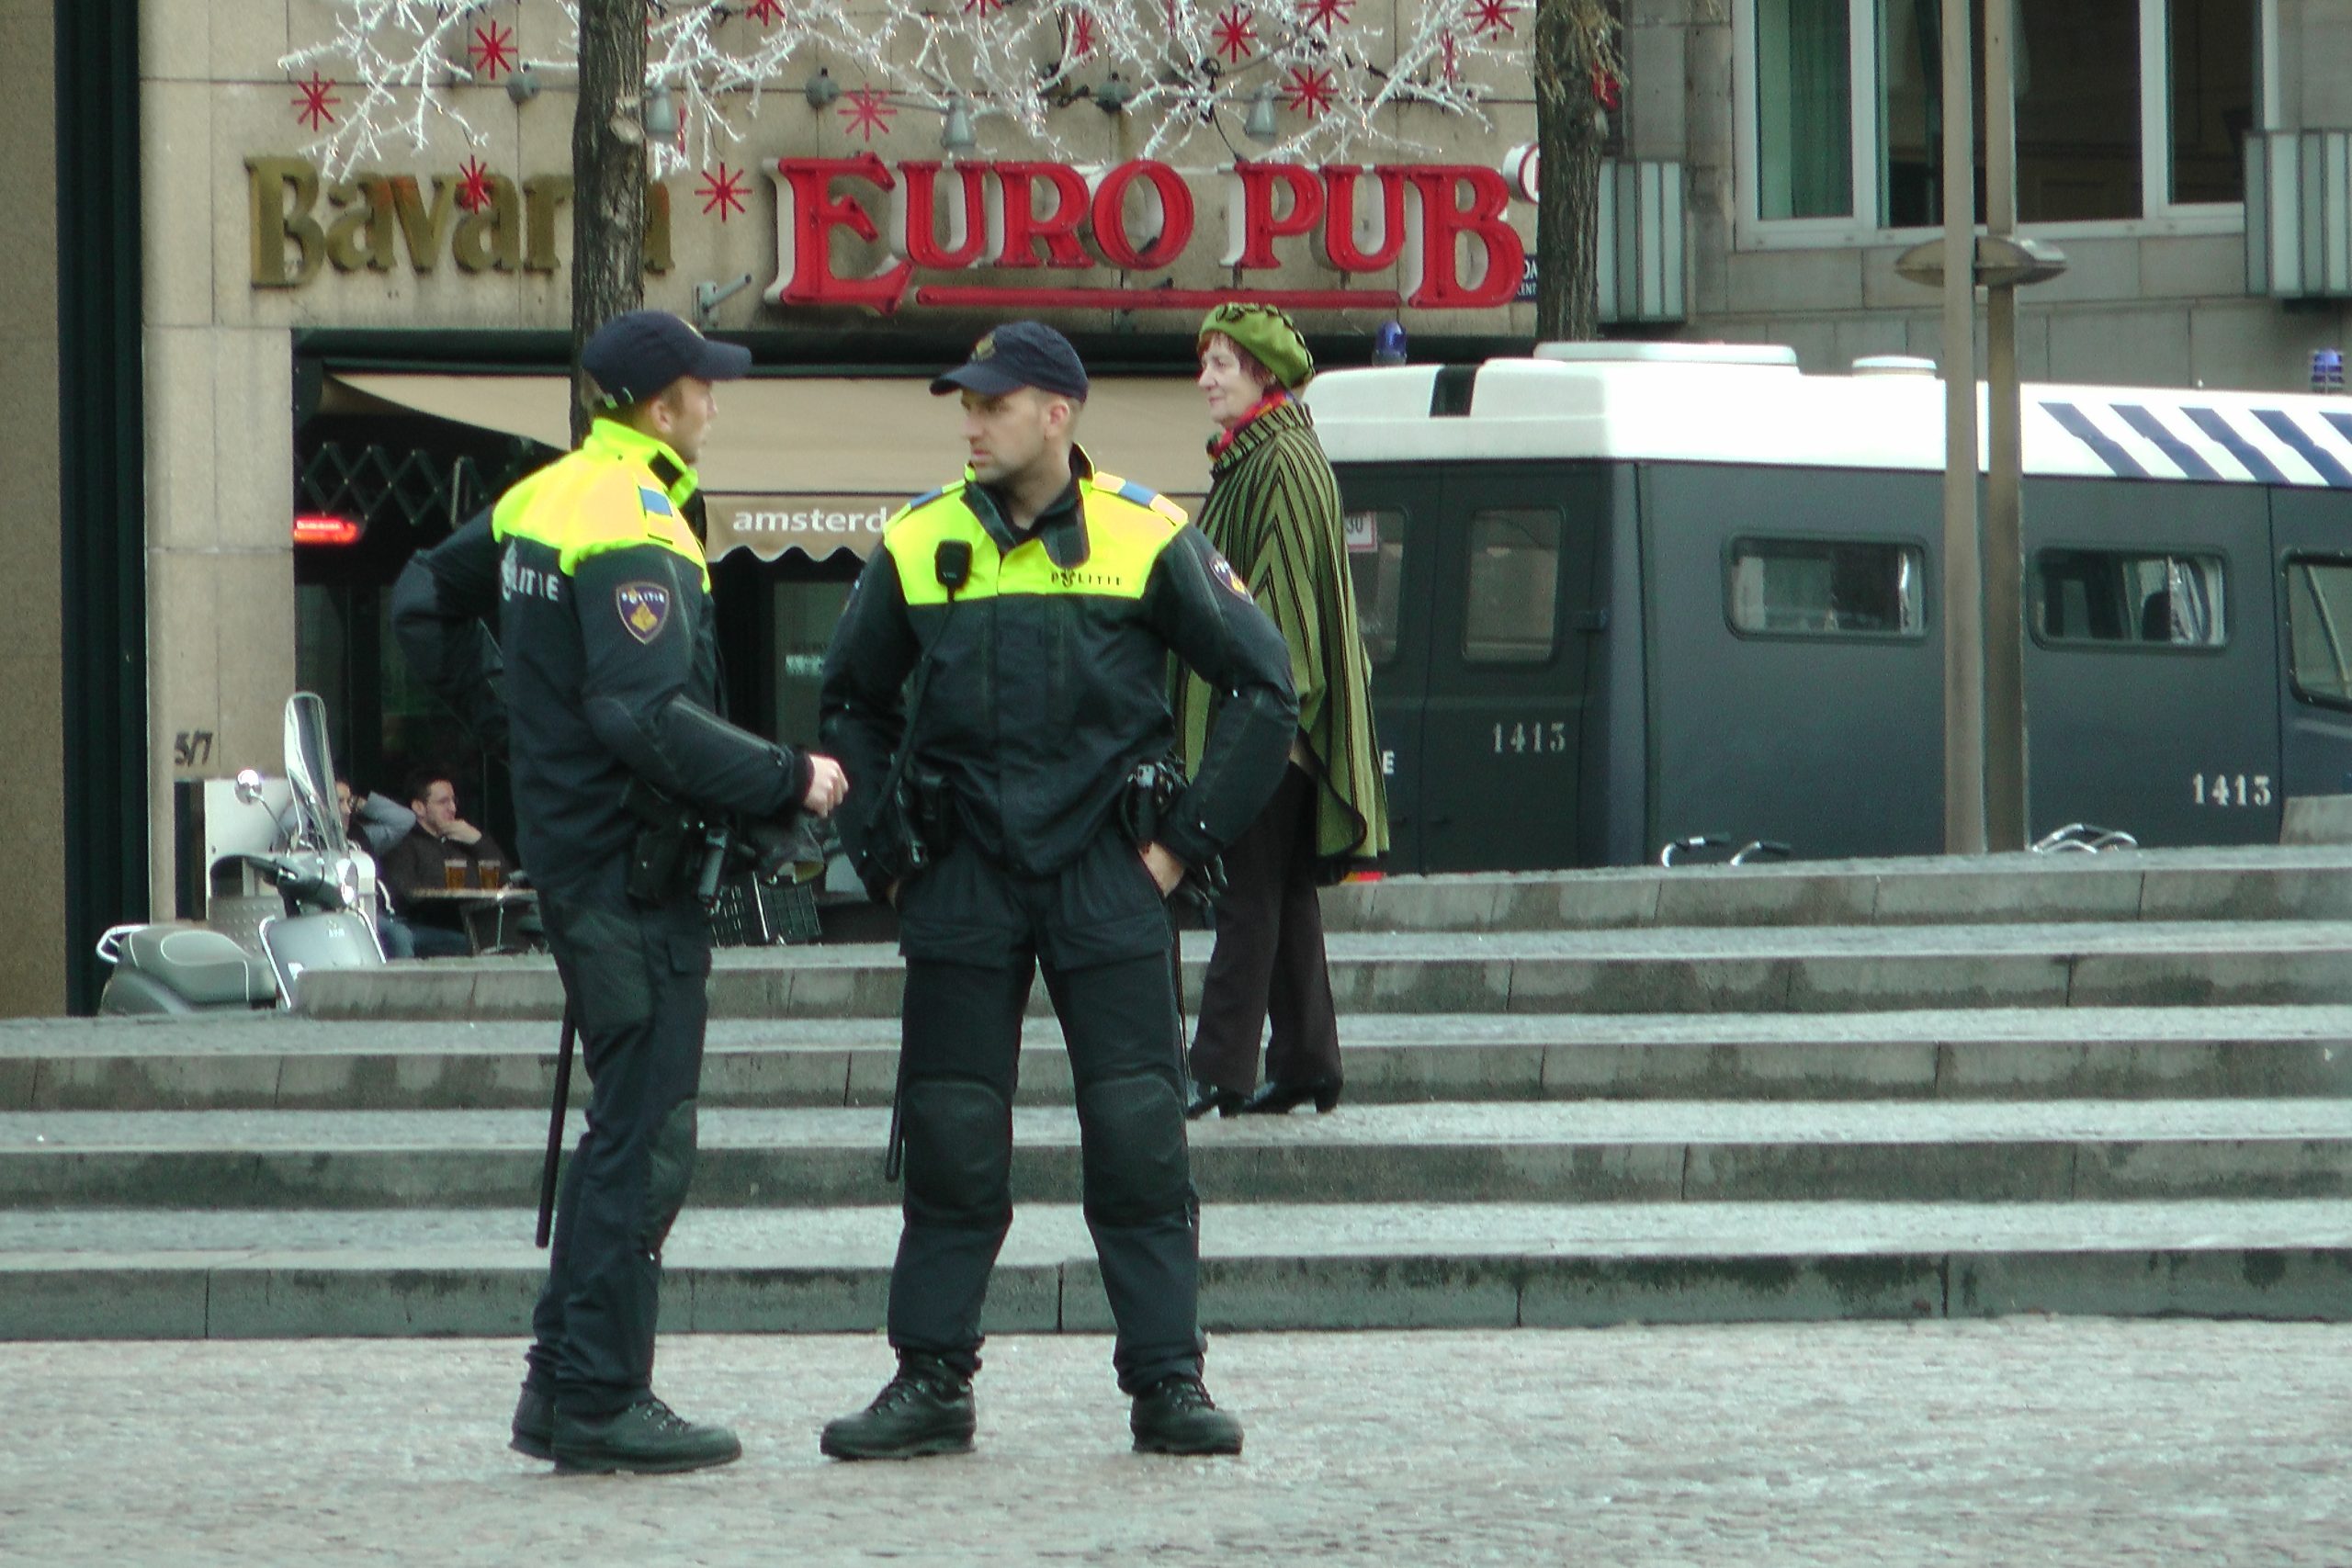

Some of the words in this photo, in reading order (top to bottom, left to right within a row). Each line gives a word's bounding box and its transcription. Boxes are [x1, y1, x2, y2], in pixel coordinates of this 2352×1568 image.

[243, 154, 675, 288] Bavar
[765, 151, 1194, 316] EURO
[1222, 160, 1524, 309] PUB
[733, 506, 888, 533] amsterd
